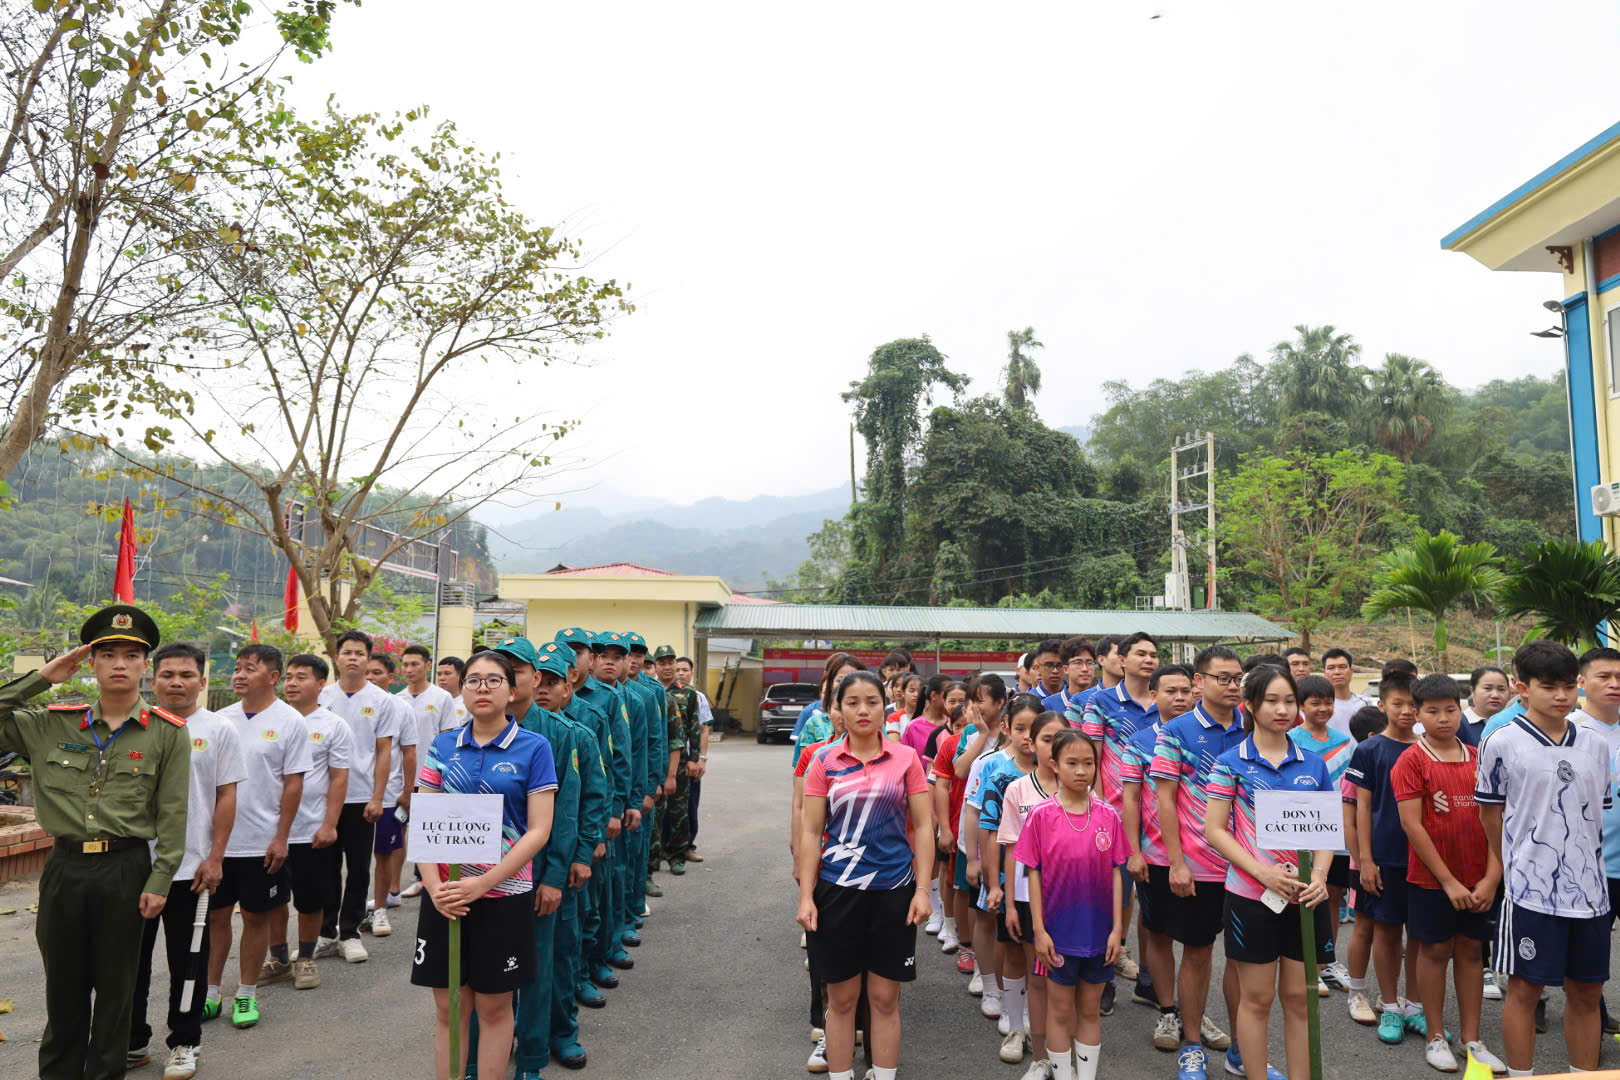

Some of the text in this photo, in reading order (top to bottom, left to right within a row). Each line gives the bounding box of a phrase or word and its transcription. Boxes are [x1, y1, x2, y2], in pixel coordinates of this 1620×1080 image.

[1019, 804, 1034, 813] EN
[1309, 810, 1321, 821] VỊ
[422, 820, 491, 834] LỰC LƯỢNG
[1265, 820, 1289, 832] CÁC
[426, 833, 486, 845] VŨ TRANG
[414, 937, 427, 965] 3
